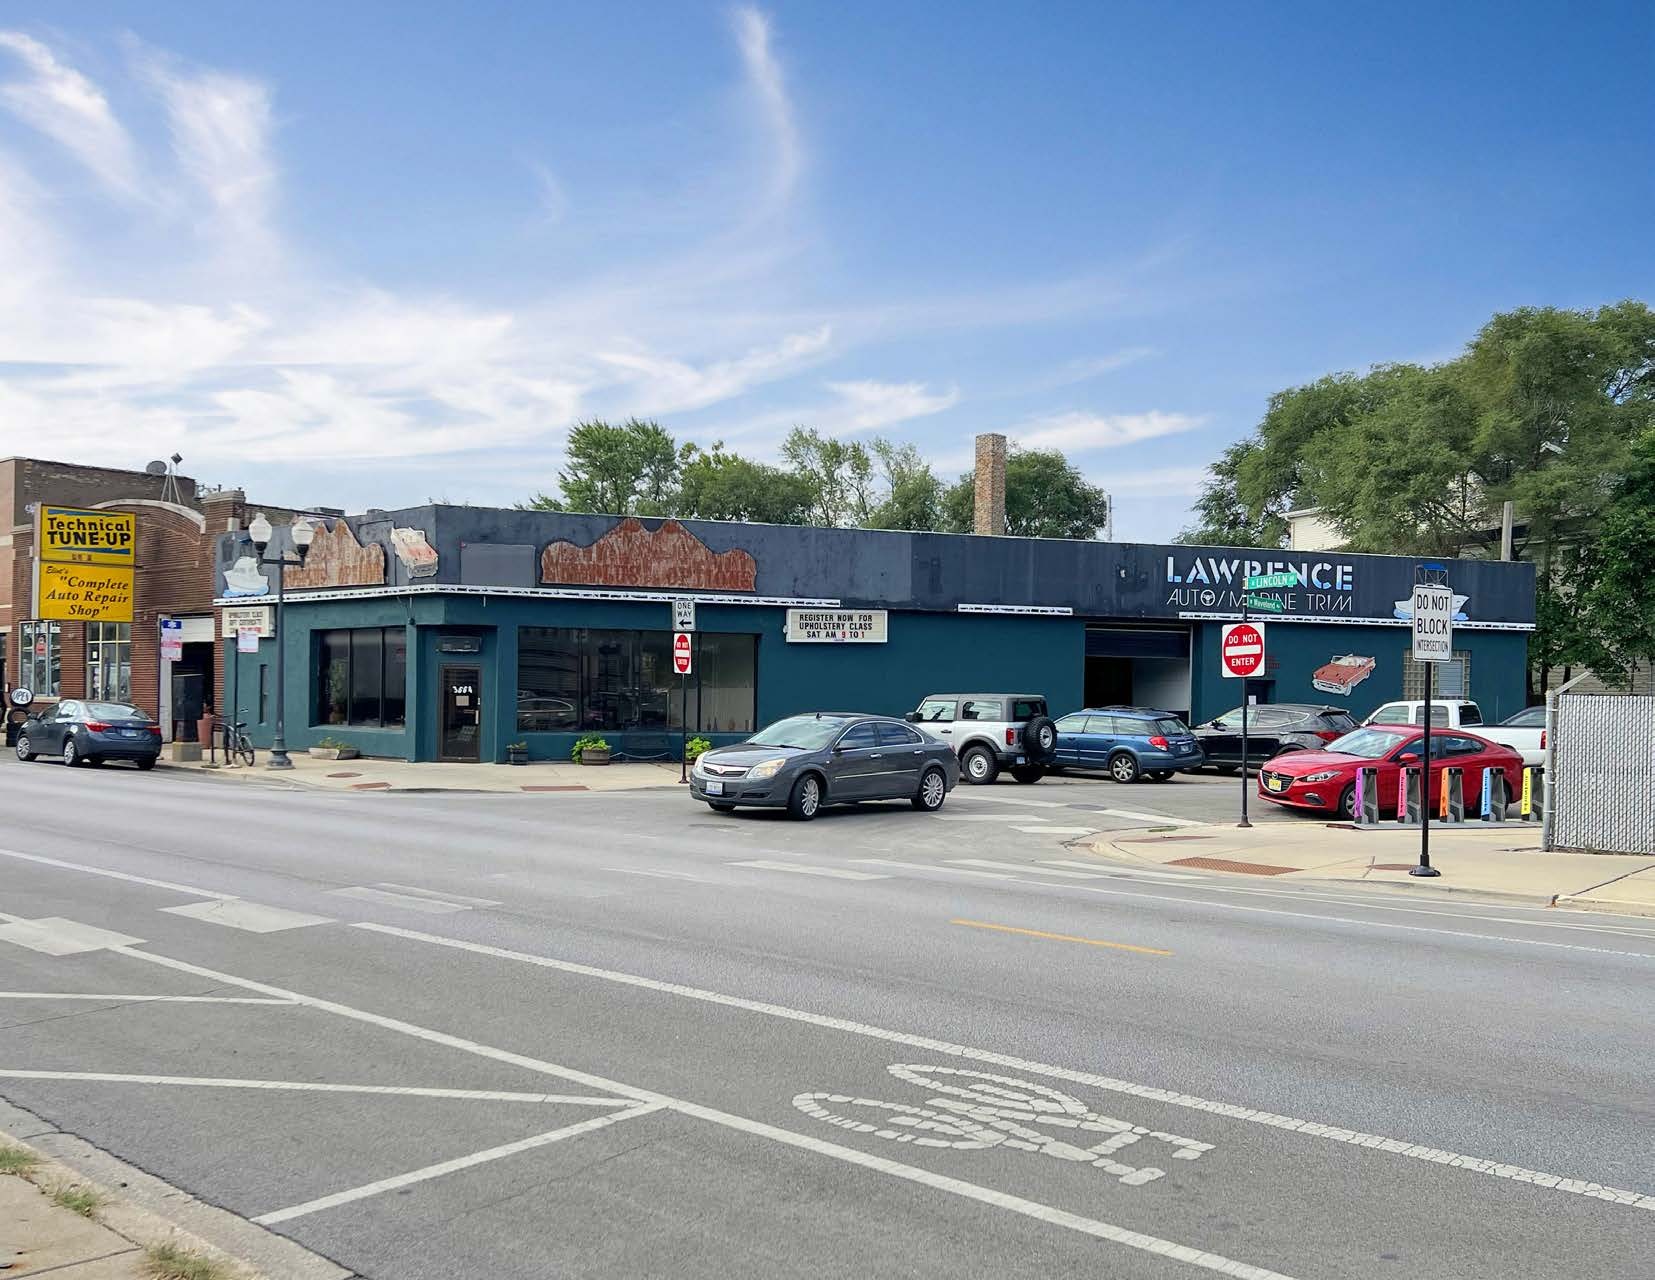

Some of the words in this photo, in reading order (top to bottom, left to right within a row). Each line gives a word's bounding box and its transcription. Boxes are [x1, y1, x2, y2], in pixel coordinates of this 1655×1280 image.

[47, 517, 131, 532] Technical
[47, 531, 131, 546] TUNE-UP
[60, 576, 129, 591] "Complete
[1256, 575, 1288, 588] LINCOLN
[46, 589, 79, 601] Auto
[84, 590, 129, 605] Repair
[1230, 591, 1297, 611] MNE
[1306, 594, 1353, 612] TRIM
[1416, 594, 1429, 610] DO
[1431, 595, 1450, 612] NOT
[68, 604, 110, 619] Shop"
[677, 602, 692, 610] ONE
[677, 610, 692, 618] WAY
[799, 614, 834, 622] REGISTER
[837, 614, 853, 622] NOW
[858, 614, 873, 622] FOR
[799, 622, 846, 631] UPHOLSTERY
[849, 623, 873, 631] CLASS
[1417, 618, 1448, 635] BLOCK
[806, 631, 821, 639] SAT
[825, 631, 837, 639] AM
[841, 631, 846, 639] 9
[849, 631, 859, 639] TO
[1228, 635, 1239, 645] DO
[1242, 633, 1258, 643] NOT
[1231, 657, 1255, 667] ENTER
